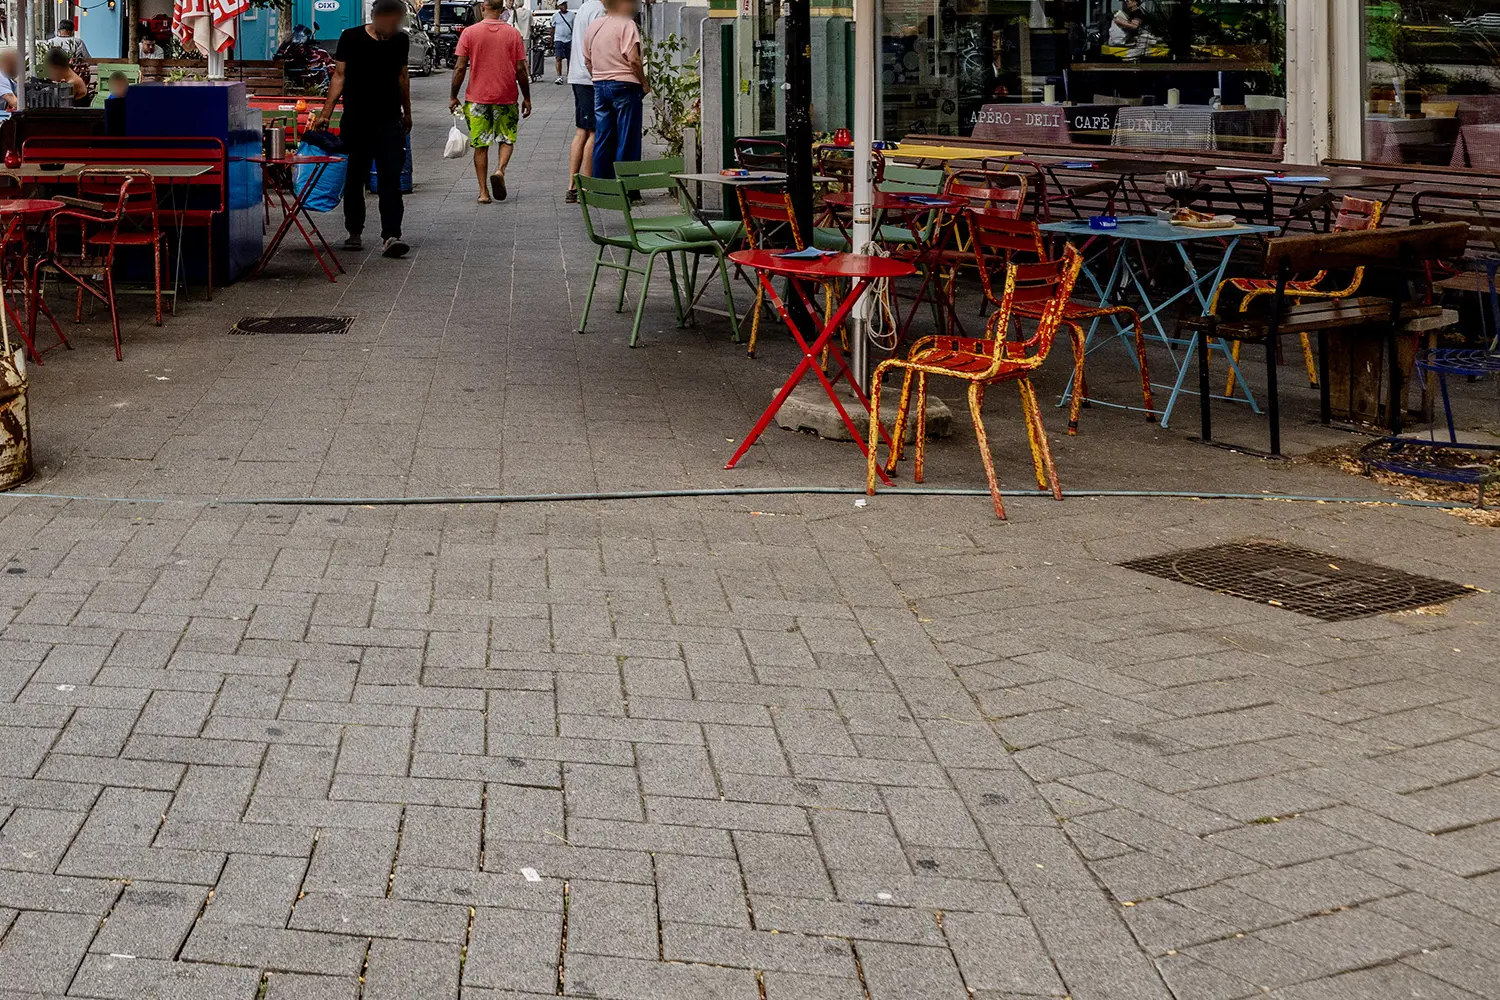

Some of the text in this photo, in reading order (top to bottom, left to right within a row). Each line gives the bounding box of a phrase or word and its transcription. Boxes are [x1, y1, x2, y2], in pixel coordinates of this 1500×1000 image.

[970, 107, 1012, 125] APÉRO
[1025, 113, 1060, 127] DELI
[1074, 113, 1110, 130] CAFÉ
